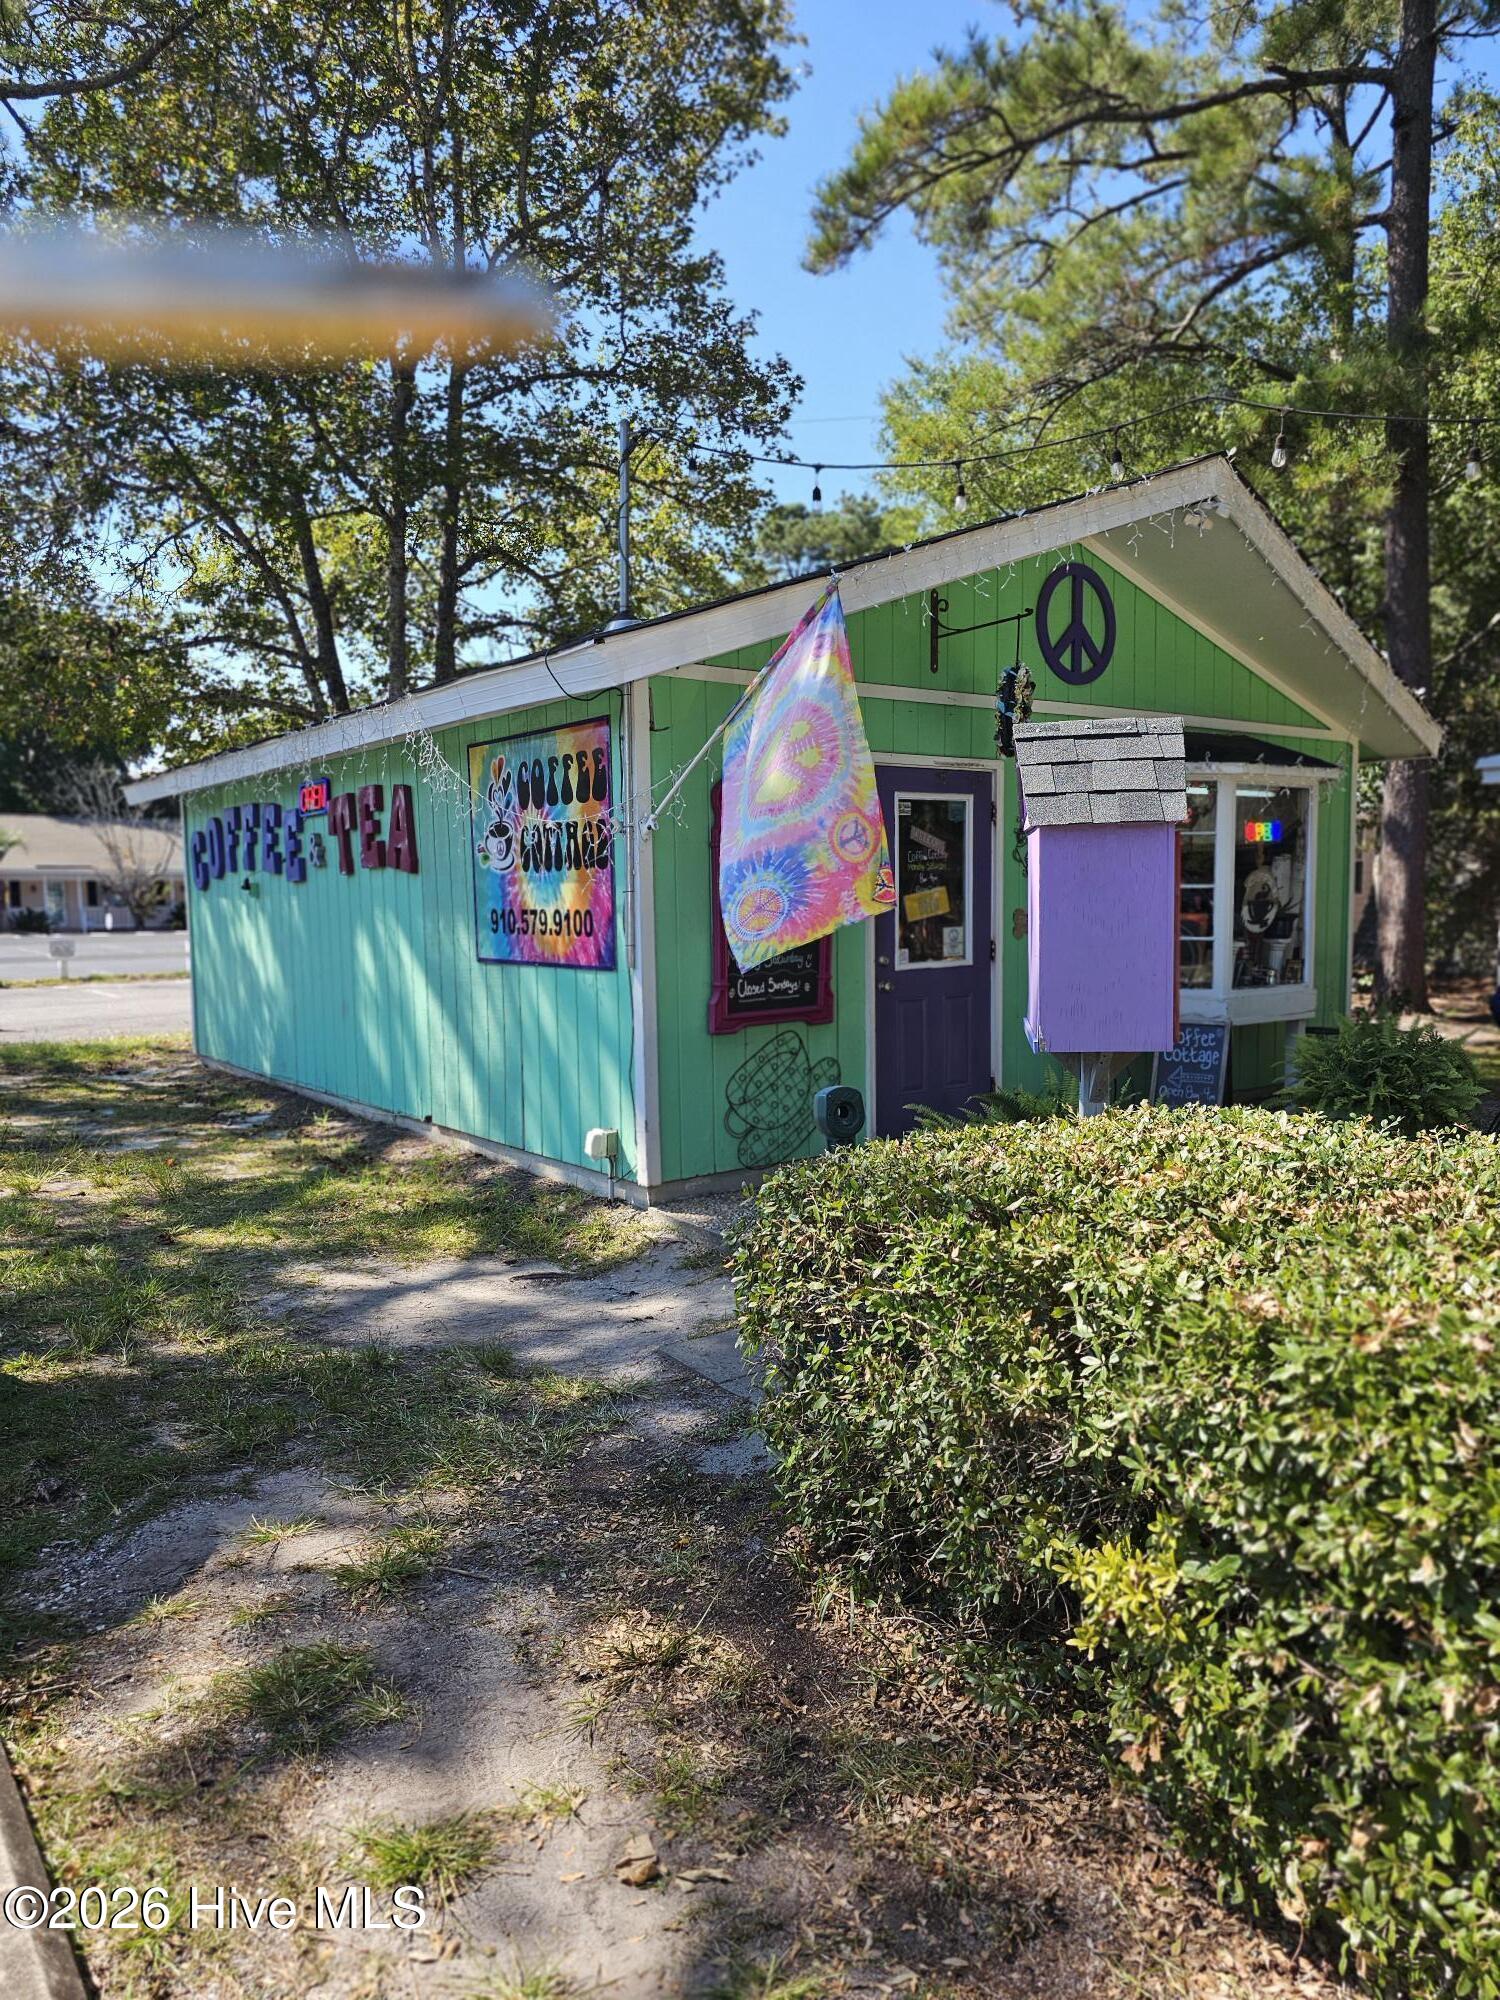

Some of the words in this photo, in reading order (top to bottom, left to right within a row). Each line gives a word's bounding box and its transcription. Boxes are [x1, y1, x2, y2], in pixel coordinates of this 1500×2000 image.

[518, 747, 609, 811] COFFEE
[191, 801, 308, 892] COFFEE
[310, 832, 327, 868] &
[328, 783, 420, 876] TEA
[519, 818, 610, 874] COTTAGE
[490, 908, 595, 938] 910.579.9100
[737, 979, 766, 997] Closed
[1177, 1027, 1217, 1048] offee
